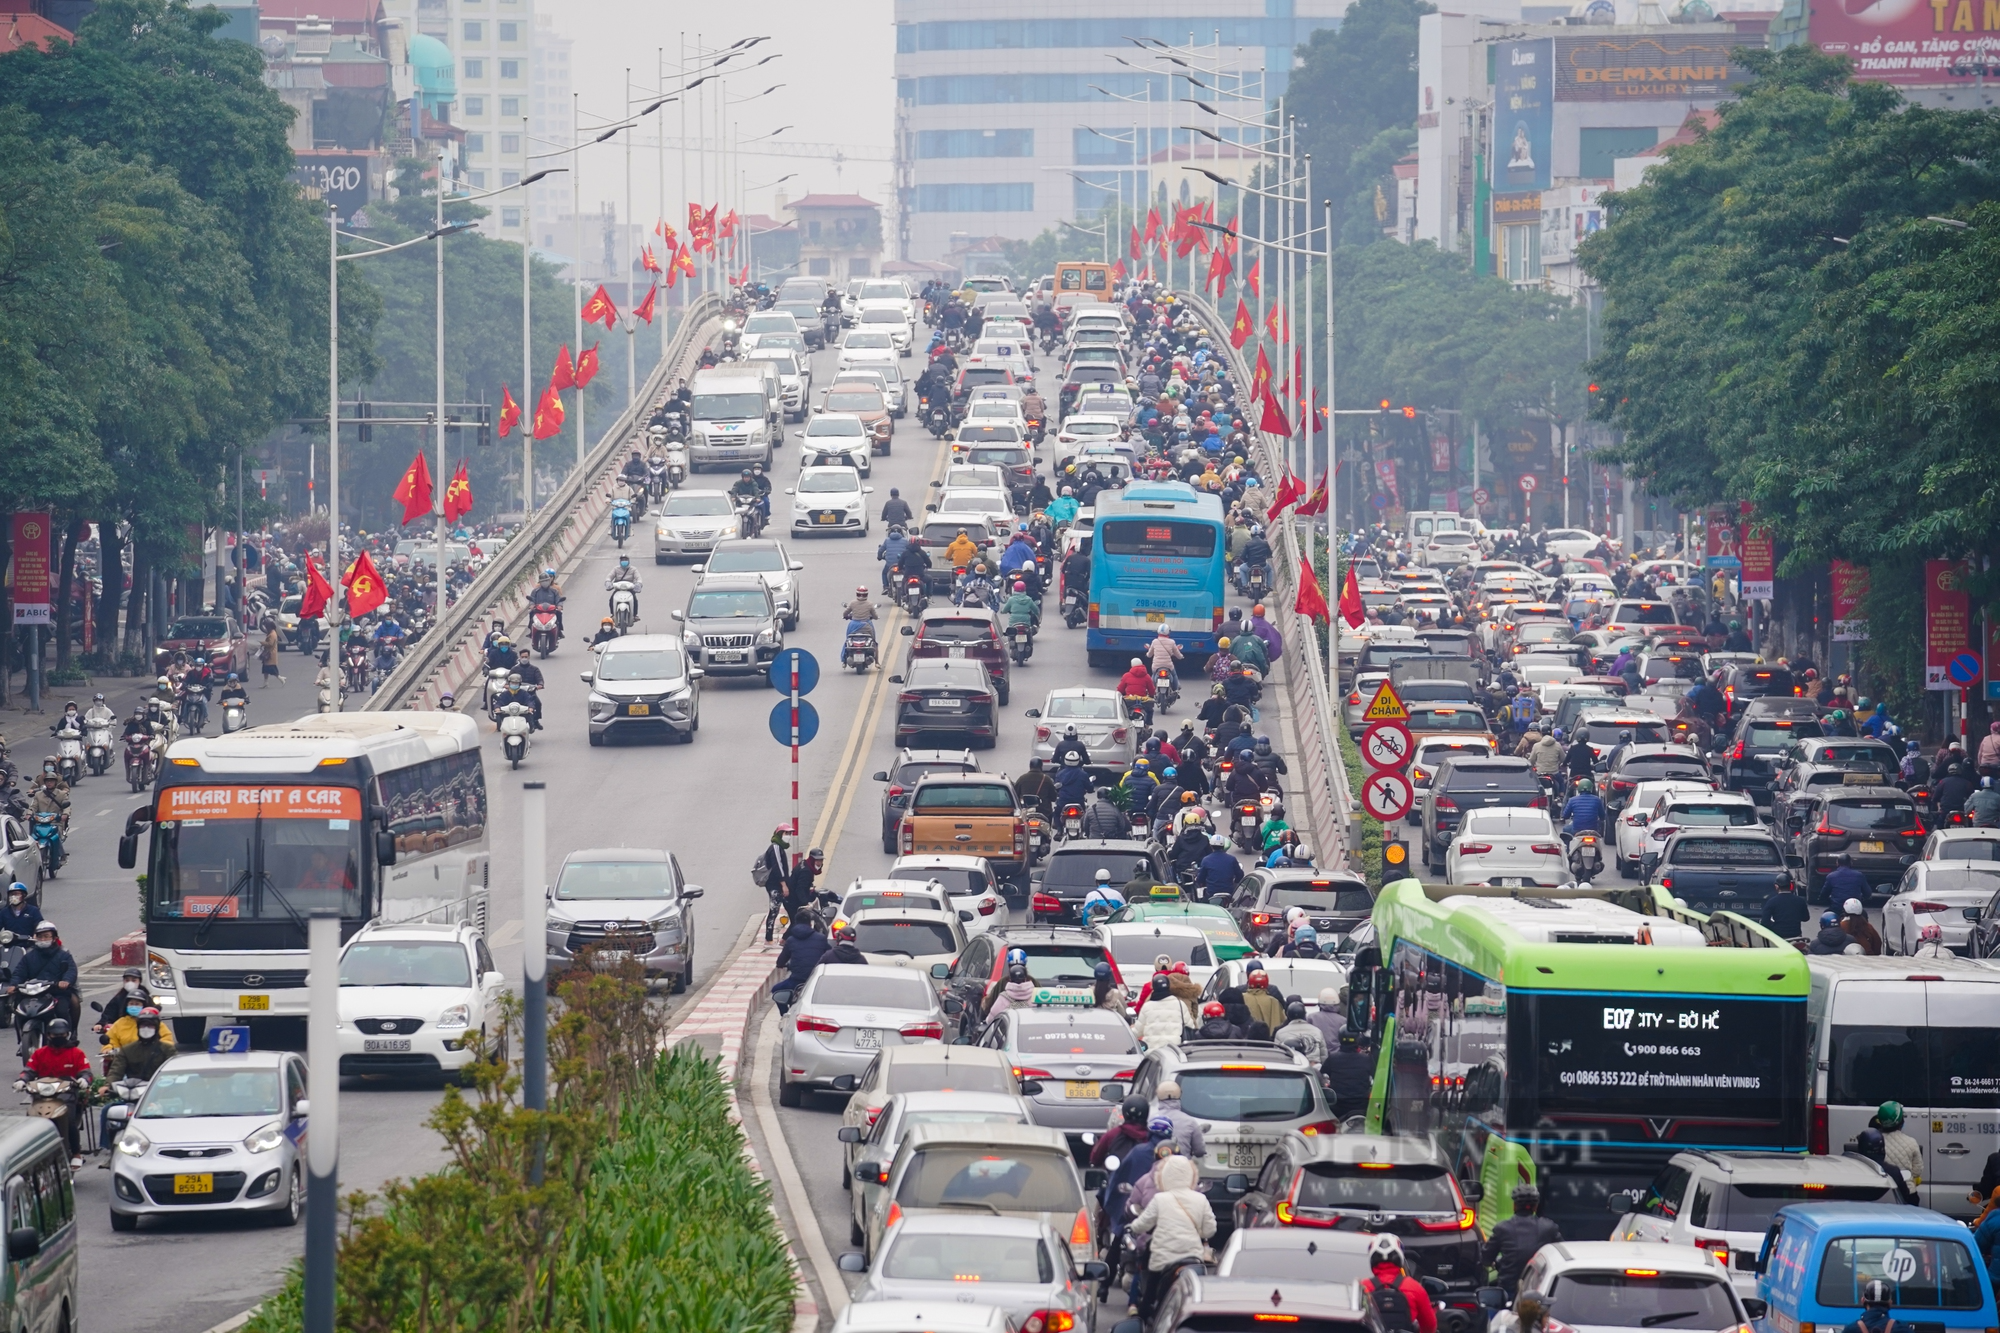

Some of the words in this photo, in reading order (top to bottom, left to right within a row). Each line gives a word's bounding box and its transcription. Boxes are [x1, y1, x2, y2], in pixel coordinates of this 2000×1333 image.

[1860, 35, 1881, 54] BỔ
[1884, 41, 1918, 54] GAN,
[1922, 37, 1960, 52] TĂNG
[1860, 58, 1908, 70] THANH
[1576, 66, 1727, 83] DEMXINH
[1615, 83, 1689, 96] LUXURY
[716, 424, 740, 432] VTV
[1752, 586, 1771, 594] ABIC
[1136, 599, 1177, 608] 29B-402.10
[1380, 696, 1392, 706] ĐI
[1371, 705, 1401, 717] CHẬM
[172, 789, 231, 806] HIKARI
[237, 789, 284, 804] RENT
[288, 789, 301, 804] A
[306, 789, 342, 805] CAR
[192, 904, 211, 913] BUS
[247, 995, 261, 1003] 29B
[1603, 1007, 1634, 1029] E07
[1678, 1010, 1699, 1029] BỜ
[862, 1029, 877, 1039] 30E
[366, 1040, 410, 1050] 30A-416.95
[856, 1038, 882, 1048] 477.34
[1632, 1044, 1657, 1054] 1900
[1659, 1045, 1679, 1055] 866
[1681, 1046, 1701, 1056] 663
[1560, 1071, 1575, 1087] GỌI
[1576, 1070, 1600, 1085] 0866
[1600, 1071, 1619, 1085] 355
[1619, 1071, 1638, 1086] 222
[1638, 1071, 1649, 1087] ĐỂ
[1649, 1072, 1666, 1087] TRỞ
[1666, 1072, 1691, 1087] THÀNH
[1692, 1073, 1714, 1088] NHÂN
[1714, 1074, 1731, 1088] VIÊN
[1732, 1076, 1761, 1089] VINBUS
[1947, 1122, 1966, 1133] 29B
[1235, 1144, 1254, 1155] 30K
[1234, 1155, 1256, 1166] 8391
[185, 1175, 202, 1183] 29A
[178, 1183, 208, 1193] 859.21
[1887, 1248, 1912, 1282] hp
